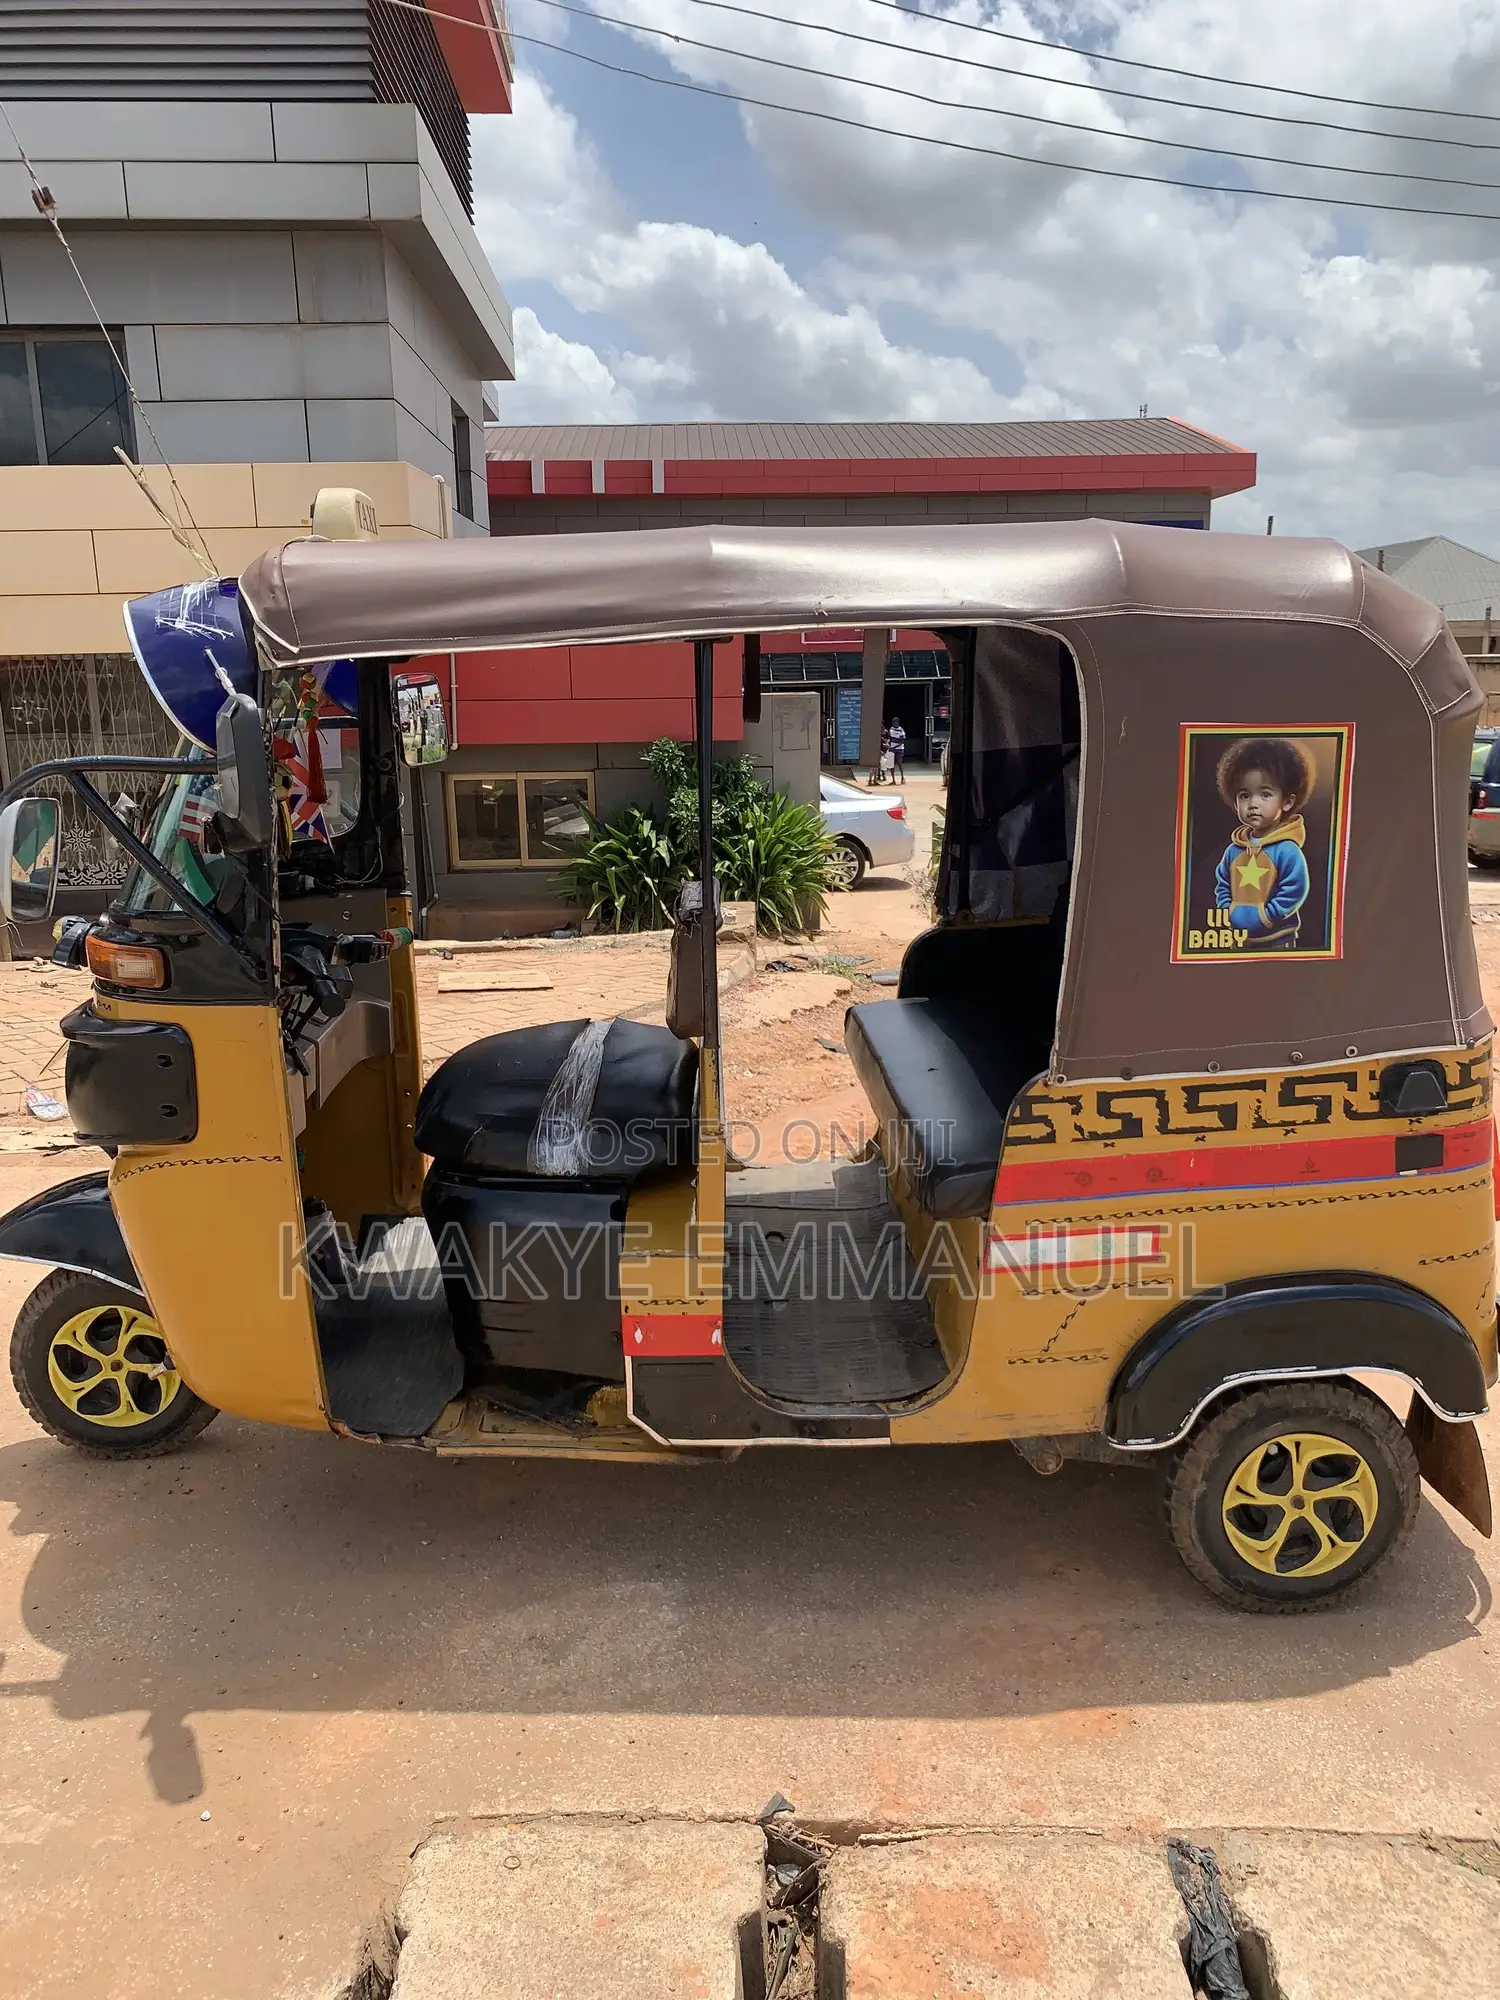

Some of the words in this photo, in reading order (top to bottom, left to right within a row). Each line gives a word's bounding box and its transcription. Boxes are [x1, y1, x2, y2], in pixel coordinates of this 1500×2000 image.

[355, 500, 379, 535] TAXI
[1206, 908, 1231, 927] LIL
[1188, 929, 1248, 948] BABY
